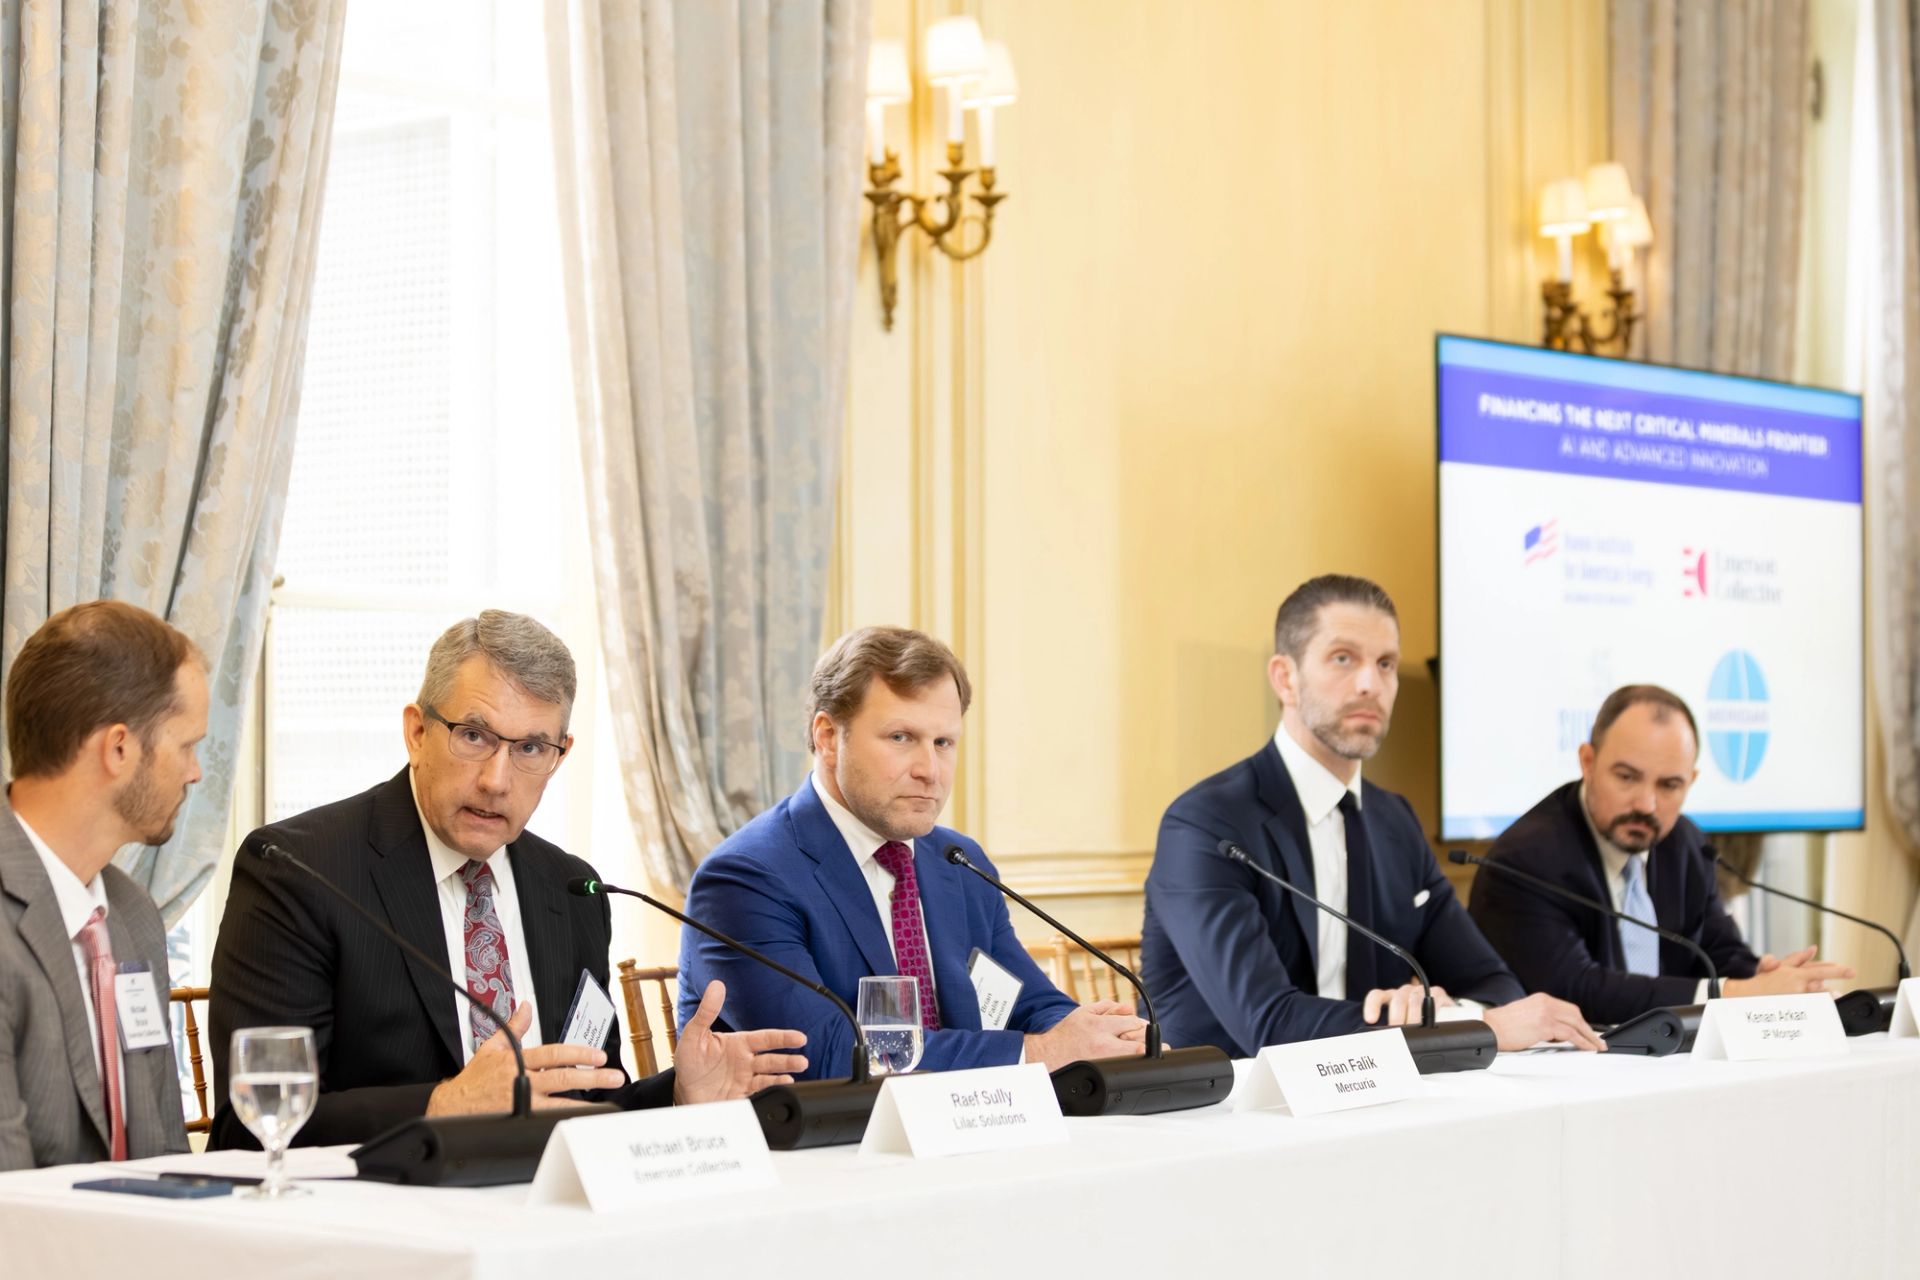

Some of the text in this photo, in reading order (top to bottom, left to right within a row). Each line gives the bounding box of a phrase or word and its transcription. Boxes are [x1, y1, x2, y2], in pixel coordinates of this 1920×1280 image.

[1479, 393, 1829, 456] FINANCING THE NEXT CRITICAL MINERALS FRONTIER
[1579, 439, 1609, 460] AND
[1613, 442, 1686, 467] ADVANCED
[1692, 451, 1769, 478] INNOVATION
[1316, 1055, 1378, 1077] Brian Falik
[1335, 1078, 1377, 1094] Mercuria
[950, 1088, 1013, 1108] Raef Sully
[953, 1112, 1027, 1130] Lilac Solutions
[628, 1134, 728, 1158] Michael Bruce
[634, 1159, 742, 1184] Emerson Collective
